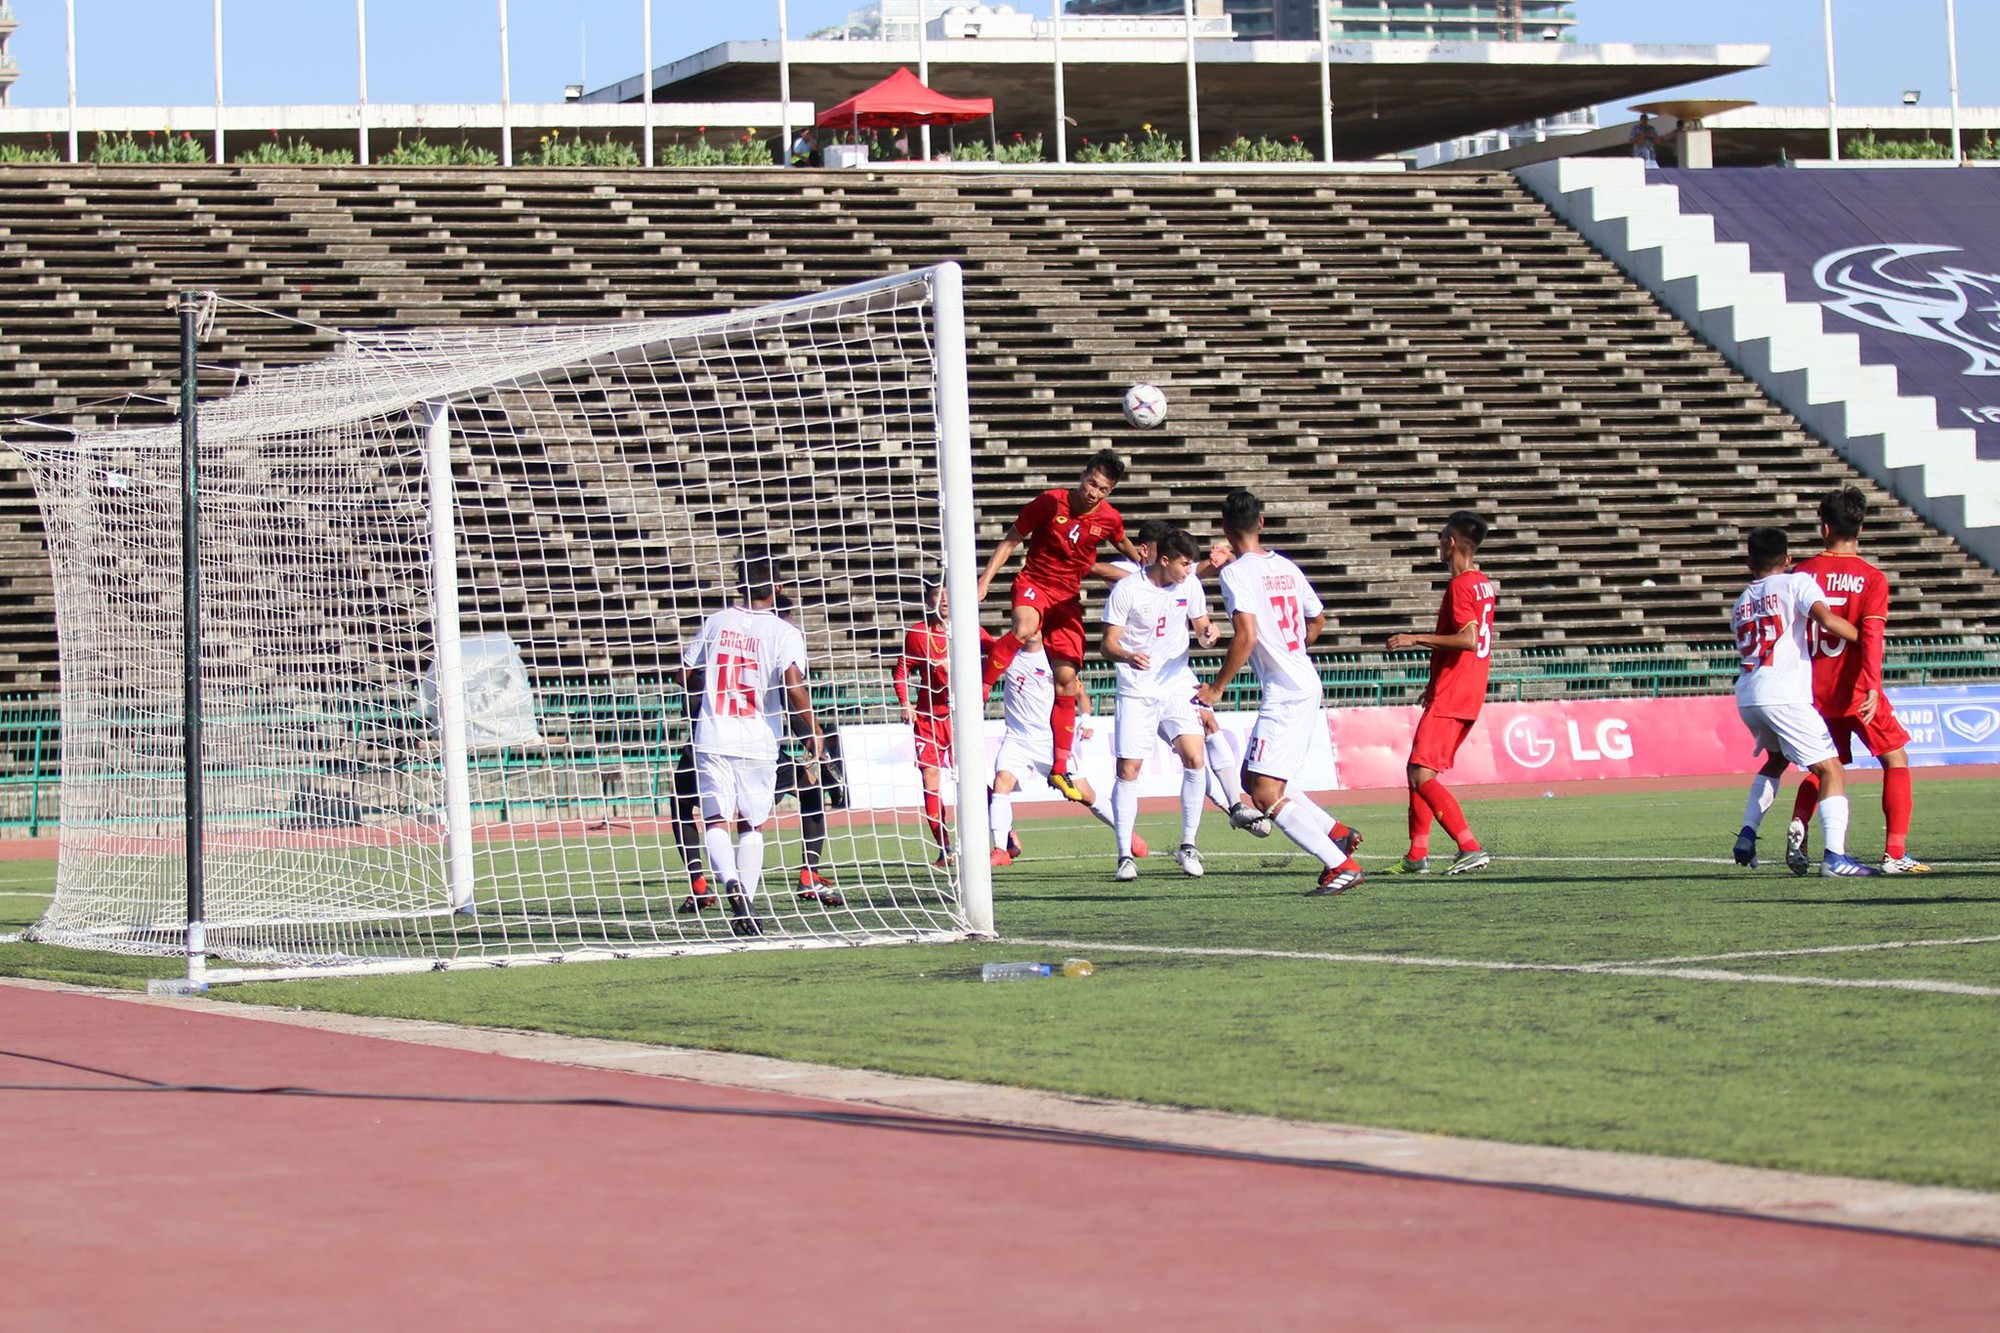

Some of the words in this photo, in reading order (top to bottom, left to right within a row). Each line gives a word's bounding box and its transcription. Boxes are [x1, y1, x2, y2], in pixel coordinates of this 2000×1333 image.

[1069, 524, 1079, 544] 4
[1826, 573, 1864, 593] THANG
[1024, 587, 1035, 600] 4
[1156, 617, 1166, 637] 2
[1270, 596, 1299, 652] 21
[1476, 603, 1492, 658] 5
[715, 653, 759, 719] 15
[1899, 709, 1934, 725] AND
[916, 742, 927, 756] 7
[1249, 737, 1265, 762] 21
[1568, 718, 1634, 761] LG
